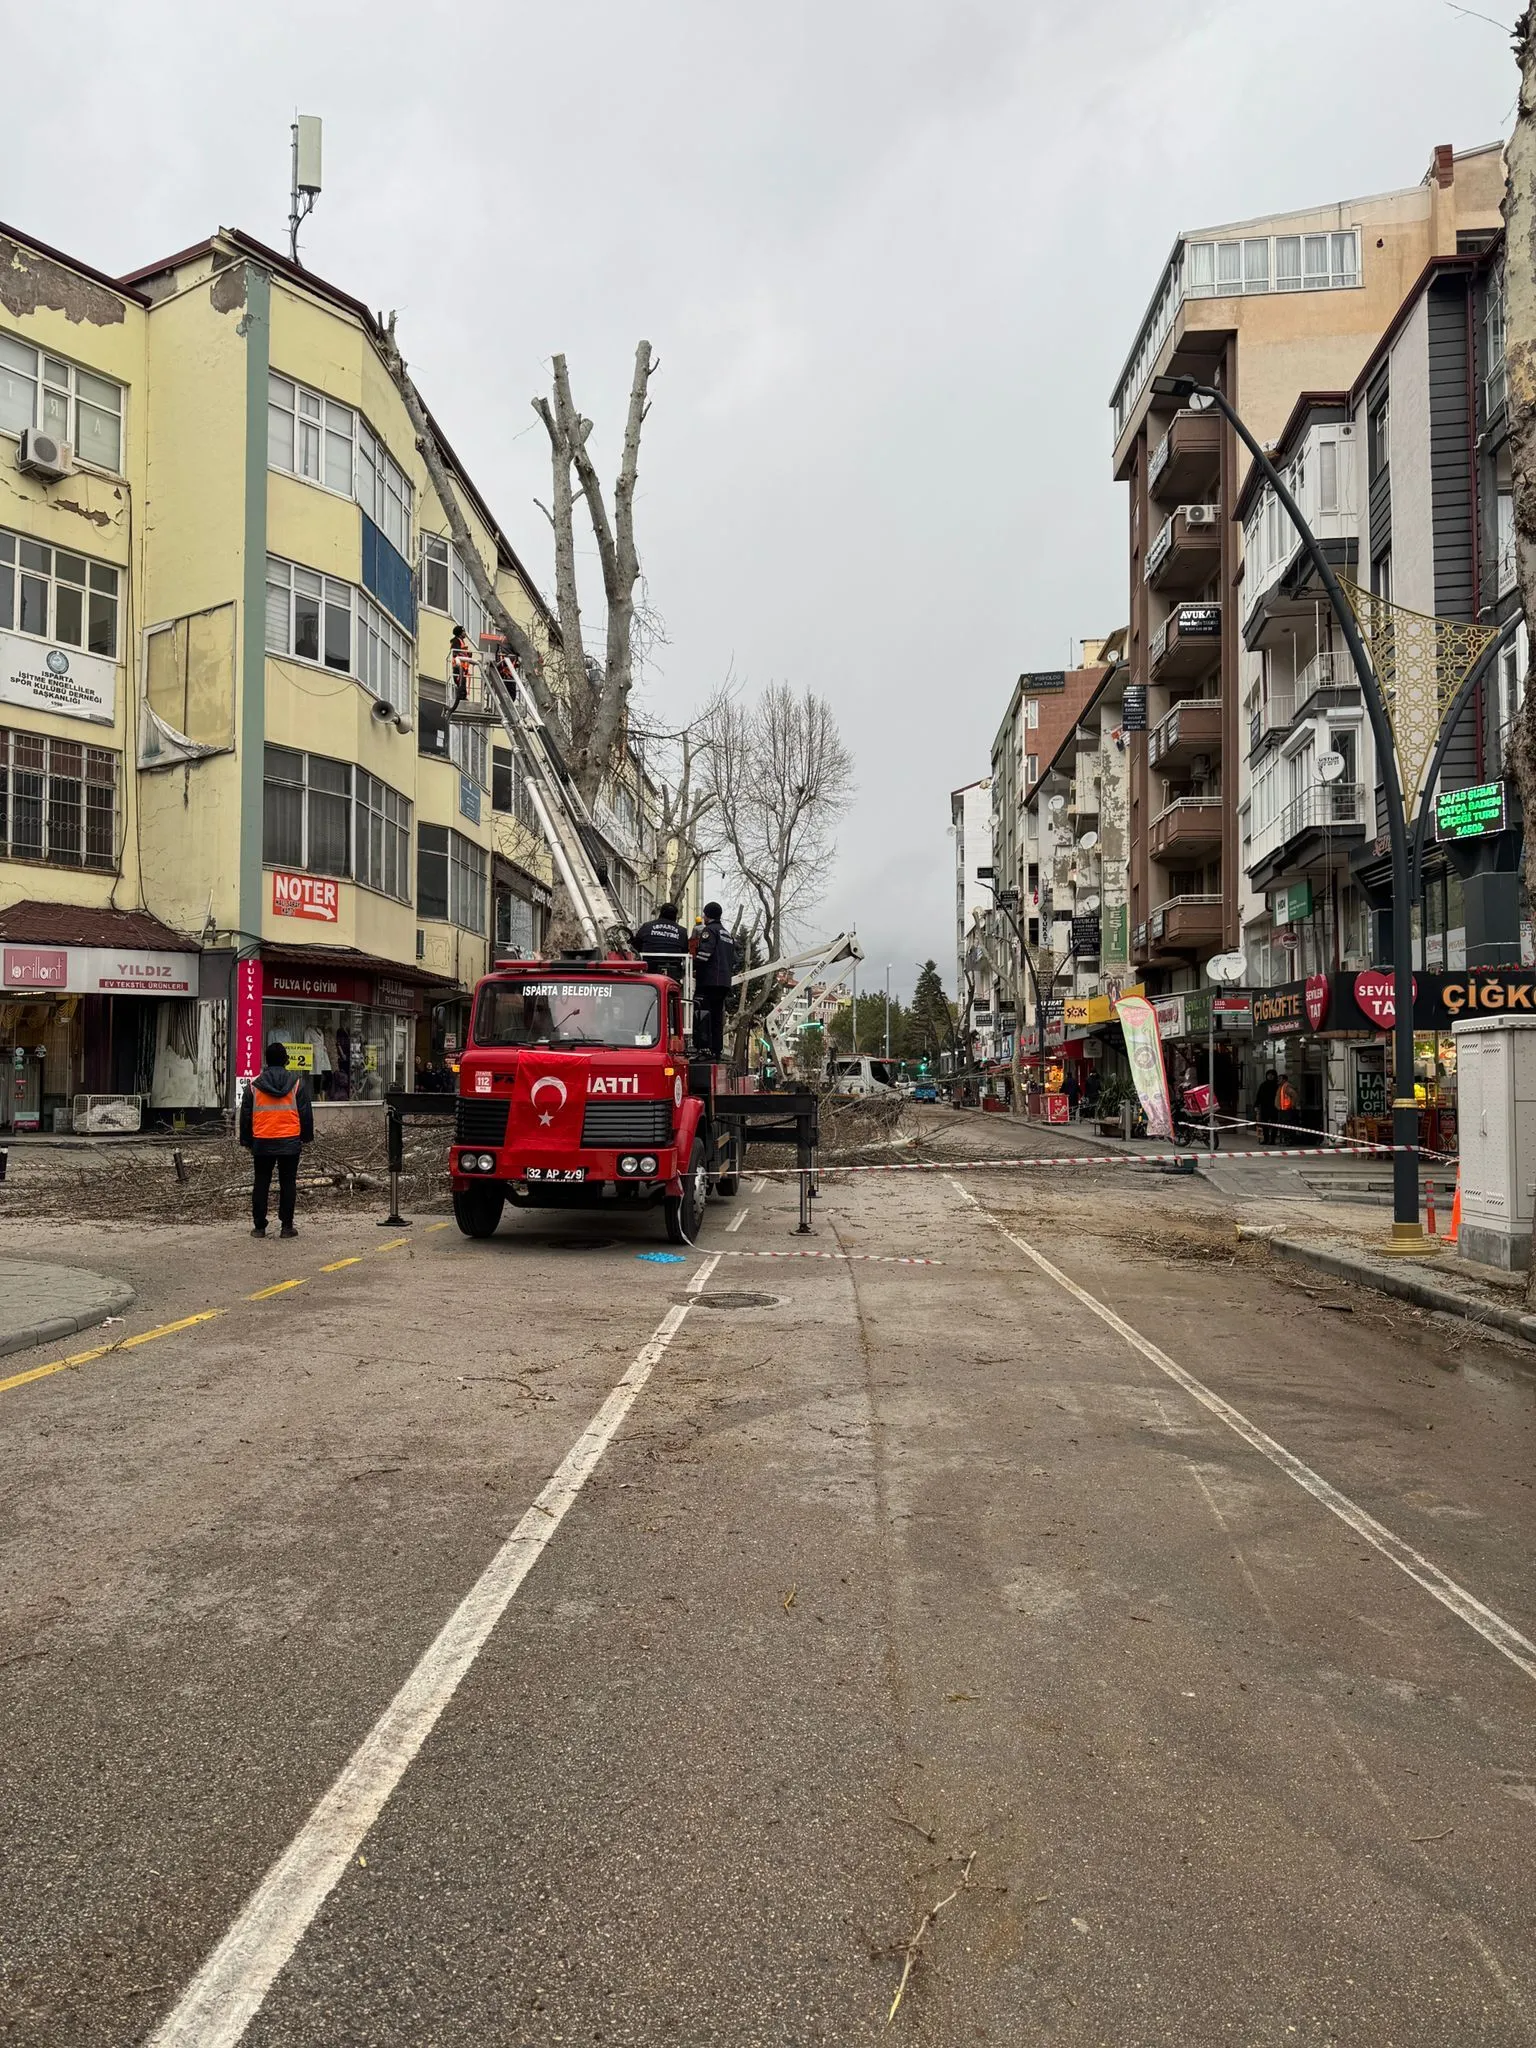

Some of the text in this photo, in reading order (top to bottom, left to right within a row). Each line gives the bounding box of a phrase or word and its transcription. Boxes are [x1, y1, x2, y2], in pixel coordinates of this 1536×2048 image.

[1180, 610, 1218, 619] AVUKAT
[10, 676, 32, 687] SPOR
[18, 670, 95, 695] İŞİTME ENGELLİLER
[41, 670, 74, 684] ISPARTA
[1440, 784, 1499, 805] 14/15 ŞUBAT
[1437, 802, 1467, 817] DATÇA
[1473, 808, 1499, 821] TURU
[276, 875, 336, 907] NOTER
[11, 955, 63, 979] brillant
[117, 964, 172, 977] YILDIZ
[147, 982, 184, 990] ÜRÜNLERİ
[273, 977, 337, 994] FULYA İÇ GİYİM
[522, 984, 612, 998] ISPARTA BELEDİYESİ
[1358, 982, 1416, 997] SEVİL
[1442, 978, 1536, 1014] ÇİĞK
[1066, 1005, 1088, 1018] ŞOK
[1310, 1003, 1321, 1018] TAT
[1371, 1000, 1396, 1016] TA
[246, 1009, 254, 1026] İÇ
[244, 1036, 253, 1076] GİYİM
[297, 1055, 306, 1067] 2
[477, 1077, 490, 1086] 112
[1359, 1073, 1385, 1088] HA
[1360, 1090, 1386, 1100] UMR
[1362, 1101, 1385, 1111] OFİ
[529, 1168, 582, 1180] 32 AP 279
